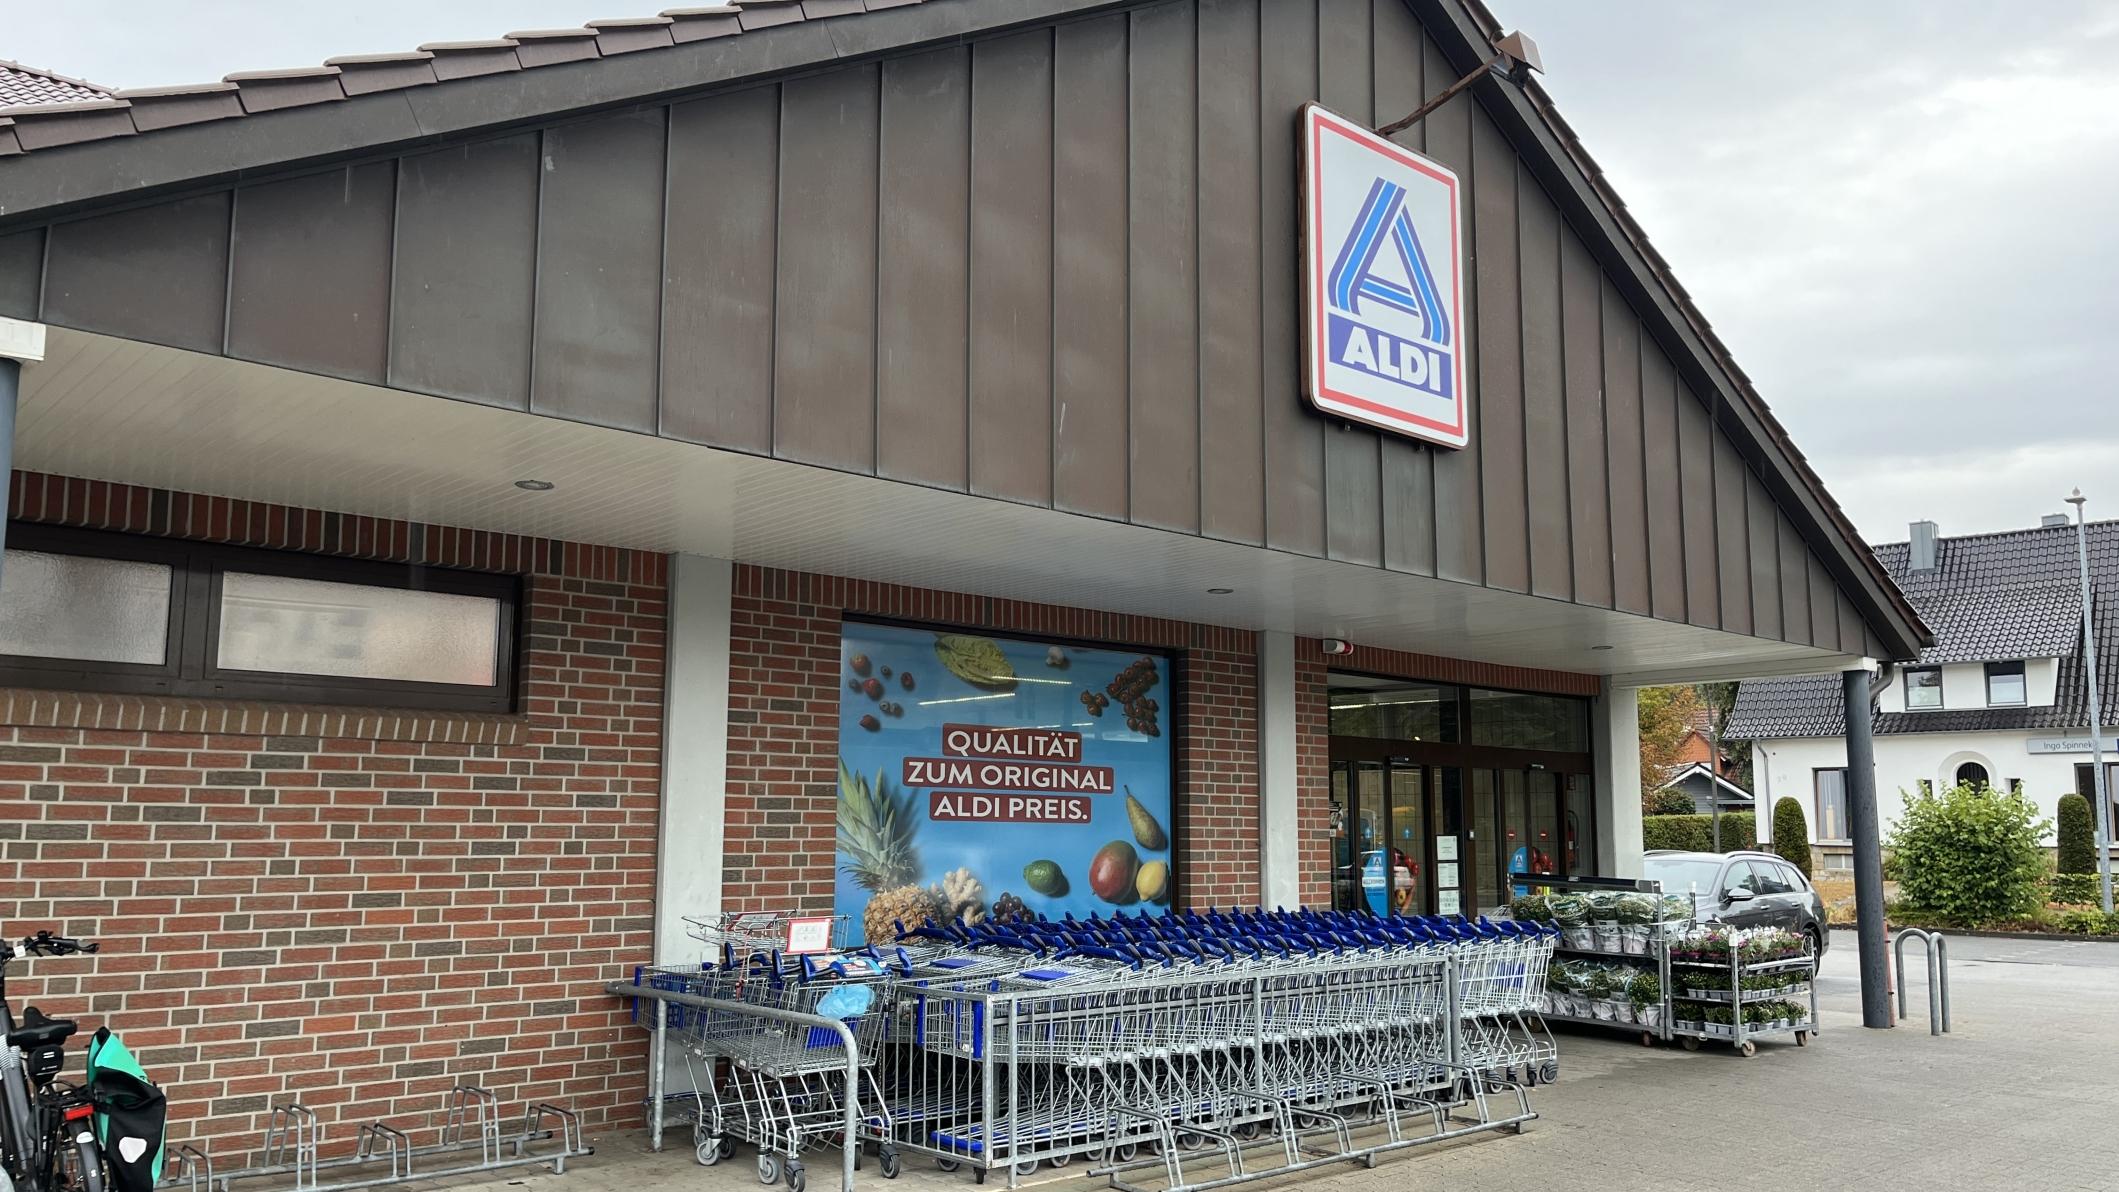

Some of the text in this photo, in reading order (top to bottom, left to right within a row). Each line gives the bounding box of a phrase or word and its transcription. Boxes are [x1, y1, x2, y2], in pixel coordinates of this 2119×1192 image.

[1342, 326, 1441, 392] ALDI
[947, 730, 1079, 758] QUALITÄT
[2043, 741, 2093, 751] Ingo Spinnek
[907, 761, 1112, 790] ZUM ORIGINAL
[933, 795, 1088, 820] ALDI PREIS.
